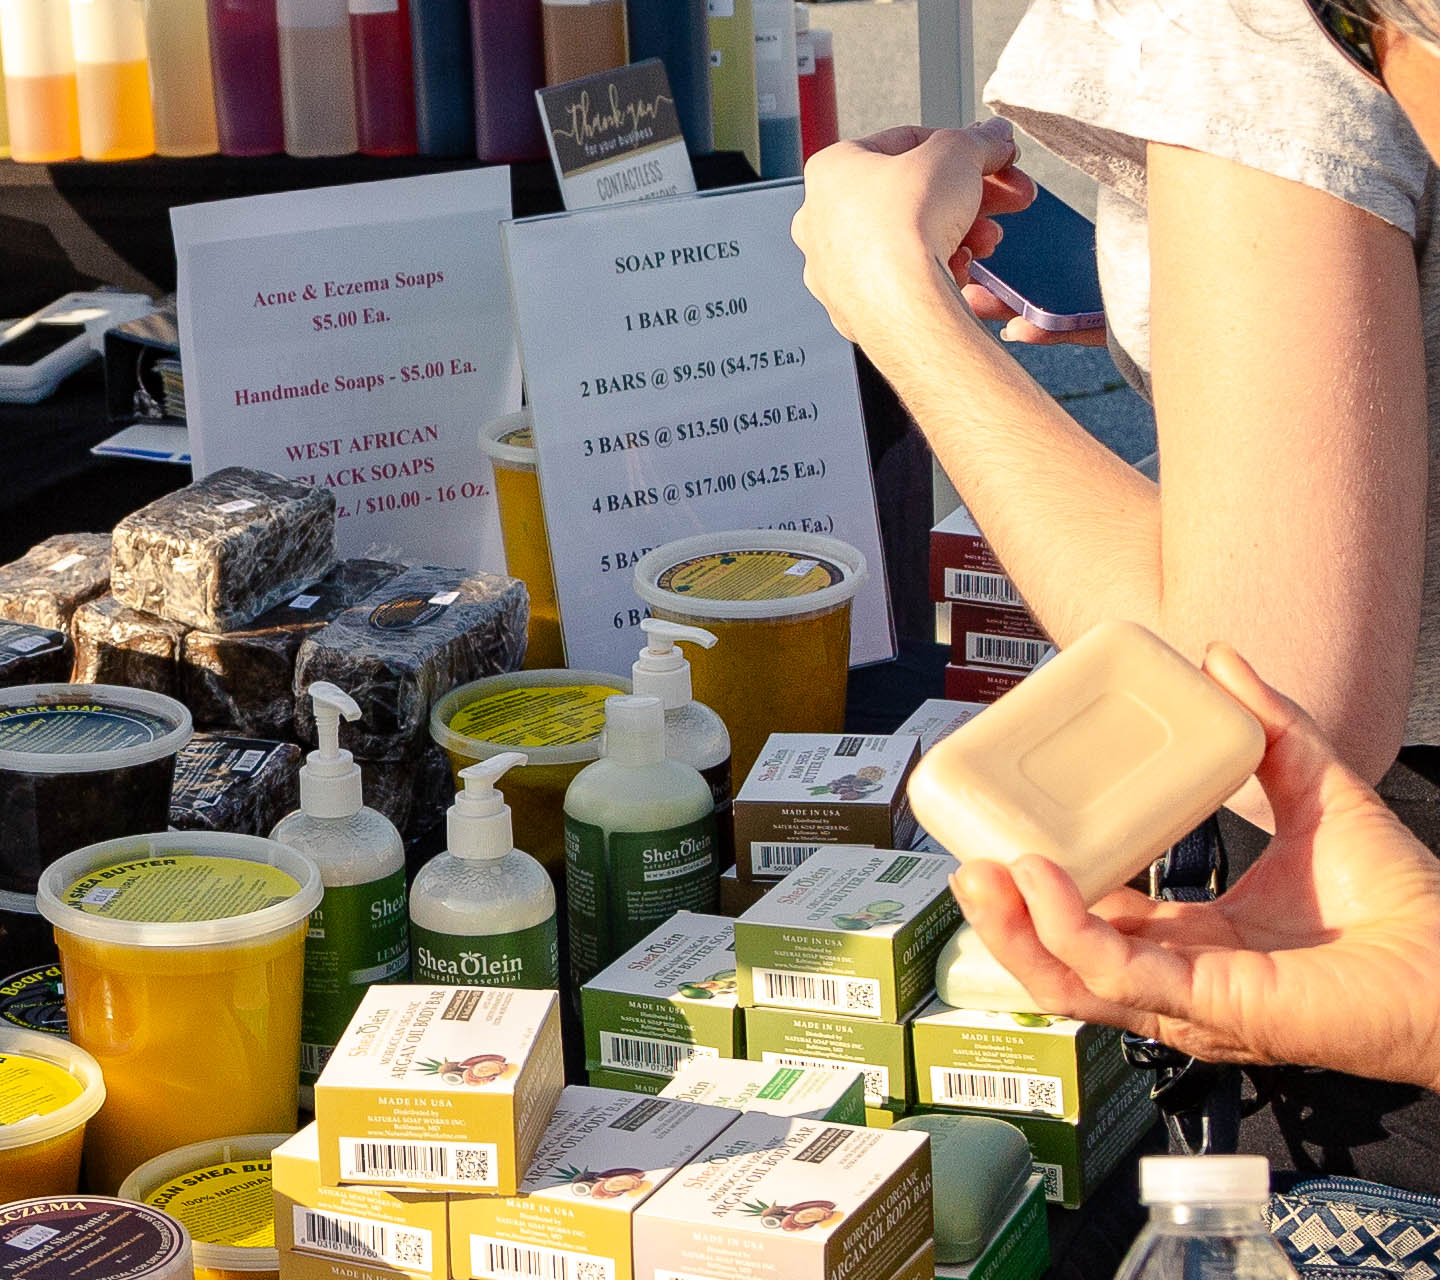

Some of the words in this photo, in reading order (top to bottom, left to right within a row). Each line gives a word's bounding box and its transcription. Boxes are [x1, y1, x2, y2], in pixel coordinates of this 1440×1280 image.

[584, 142, 598, 156] for
[599, 136, 617, 154] your
[596, 159, 663, 202] CONTACTLESS
[615, 250, 666, 274] SOAP
[671, 240, 740, 267] PRICES
[253, 290, 297, 308] Acne
[302, 284, 318, 301] &
[324, 277, 390, 298] Eczema
[396, 270, 444, 289] Soaps
[312, 310, 358, 332] $5.00
[363, 308, 390, 324] Ea.
[625, 315, 634, 331] 1
[639, 308, 679, 329] BAR
[682, 305, 702, 326] @
[706, 296, 748, 319] $5.00
[234, 379, 329, 406] Handmade
[335, 374, 385, 394] Soaps
[400, 361, 444, 384] $5.00
[450, 359, 477, 376] Ea.
[580, 381, 591, 398] 2
[595, 371, 647, 396] BARS
[650, 367, 669, 390] @
[673, 360, 716, 385] $9.50
[720, 351, 769, 379] ($4.75
[773, 346, 807, 367] Ea.)
[286, 438, 343, 462] WEST
[350, 424, 440, 452] AFRICAN
[584, 439, 594, 458] 3
[599, 429, 650, 455] BARS
[654, 427, 673, 448] @
[678, 417, 729, 442] $13.50
[733, 407, 783, 435] ($4.50
[785, 402, 819, 424] Ea.)
[371, 456, 436, 481] SOAPS
[592, 497, 602, 515] 4
[607, 488, 659, 513] BARS
[662, 483, 681, 506] @
[684, 474, 737, 499] $17.00
[741, 463, 790, 491] ($4.25
[794, 458, 826, 480] Ea.)
[366, 491, 420, 513] $10.00
[437, 484, 456, 502] 16
[460, 481, 490, 498] Oz.
[56, 703, 106, 713] SOAP
[467, 973, 522, 985] essential
[654, 962, 683, 990] OLIVE
[677, 939, 713, 973] BUTTER
[378, 1097, 410, 1105] MADE
[431, 1099, 453, 1108] USA
[865, 1220, 885, 1253] OIL
[885, 1198, 913, 1237] BODY
[911, 1173, 931, 1208] BAR
